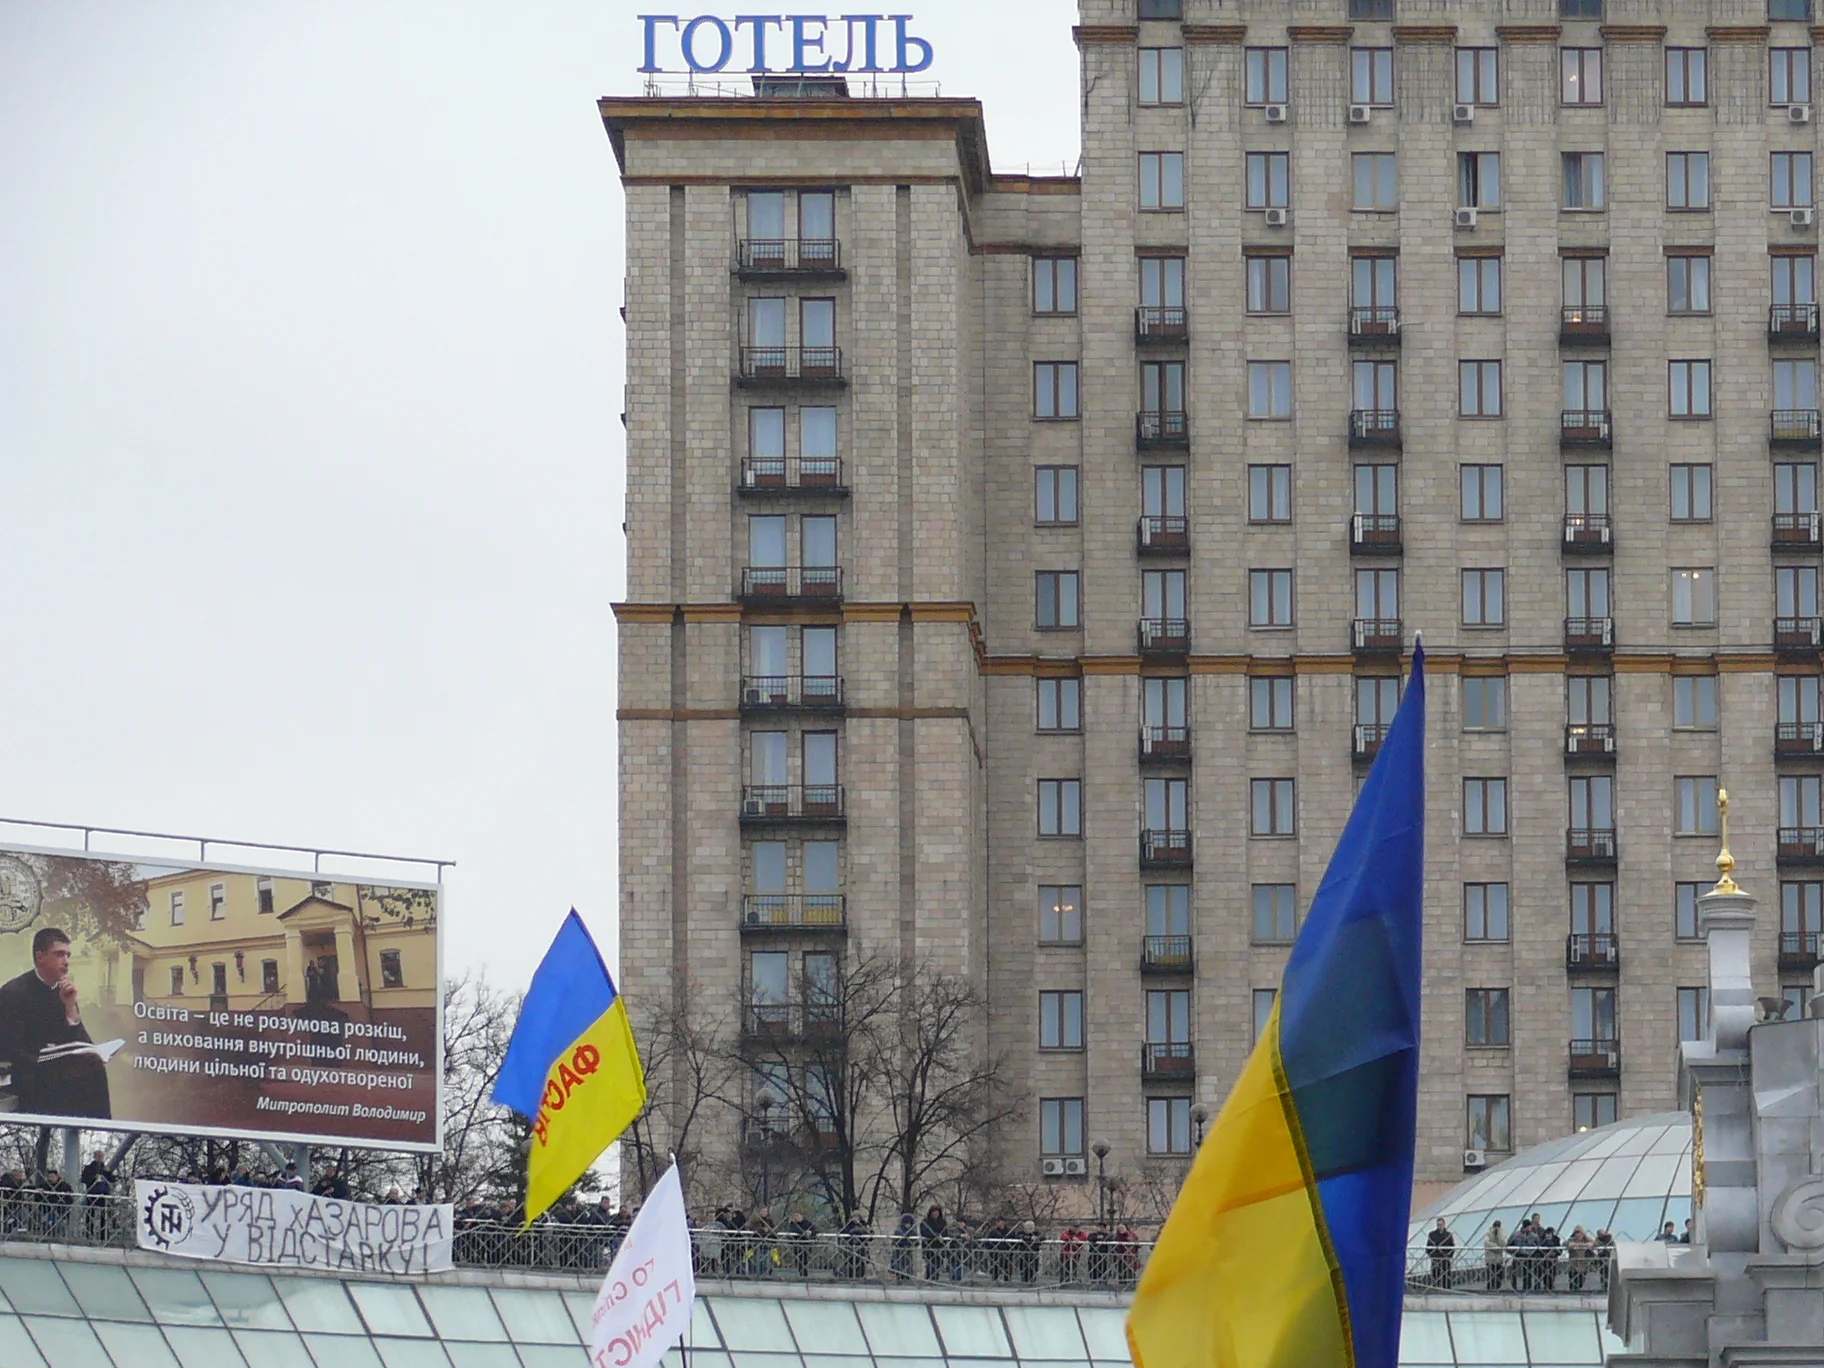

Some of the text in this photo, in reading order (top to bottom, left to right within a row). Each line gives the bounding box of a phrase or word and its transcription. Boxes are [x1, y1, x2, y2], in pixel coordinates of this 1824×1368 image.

[637, 14, 934, 74] ГОТЕЛЬ
[133, 1002, 407, 1042] Освіта це не розумова розкіш,
[138, 1031, 425, 1068] а виховання внутрішньої людини,
[133, 1055, 413, 1090] людини цільної та одухотвореної
[256, 1096, 426, 1122] Митрополит Володимир
[200, 1191, 276, 1226] УРЯД
[213, 1224, 231, 1258] У
